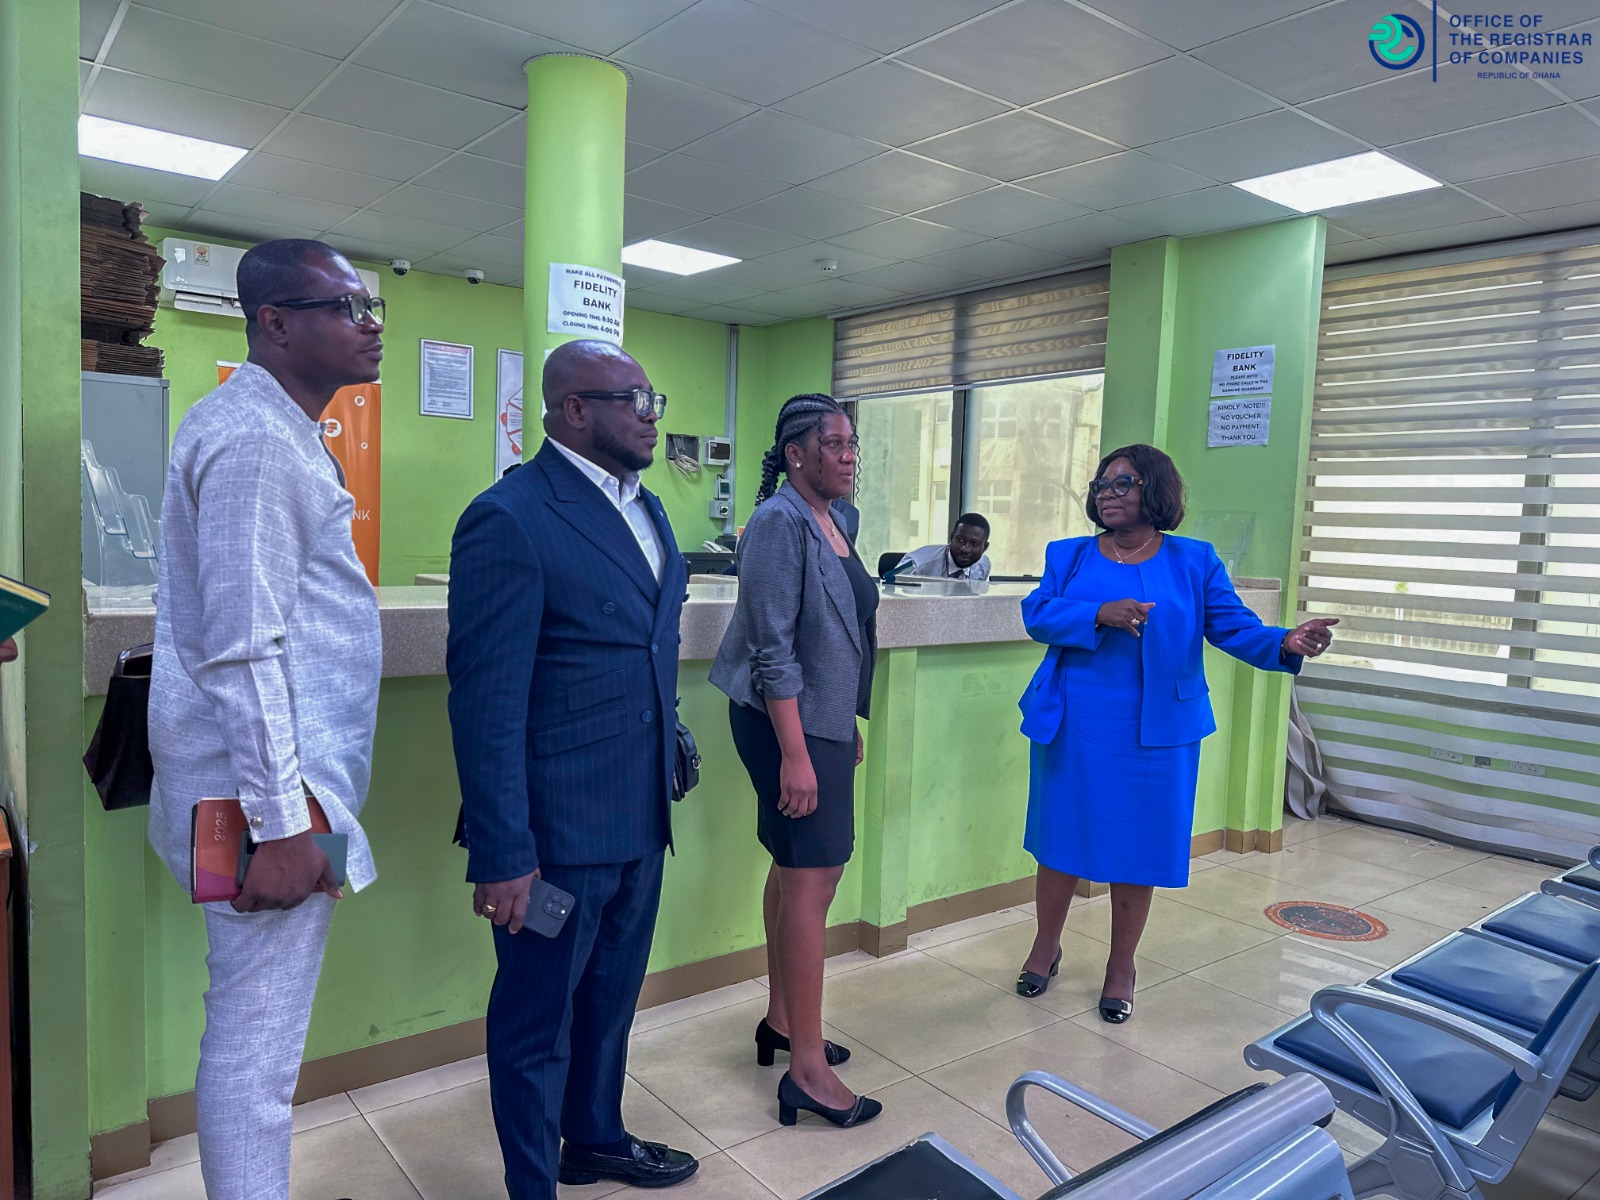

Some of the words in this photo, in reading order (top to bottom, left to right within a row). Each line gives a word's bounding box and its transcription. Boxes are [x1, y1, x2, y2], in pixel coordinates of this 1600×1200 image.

[573, 279, 618, 298] FIDELITY
[583, 297, 612, 312] BANK
[562, 310, 588, 318] OPENING
[562, 320, 586, 328] CLOSING
[600, 326, 612, 334] 4:00
[1226, 351, 1264, 360] FIDELITY
[1232, 363, 1257, 372] BANK
[352, 509, 371, 521] NK
[214, 810, 228, 842] 2025
